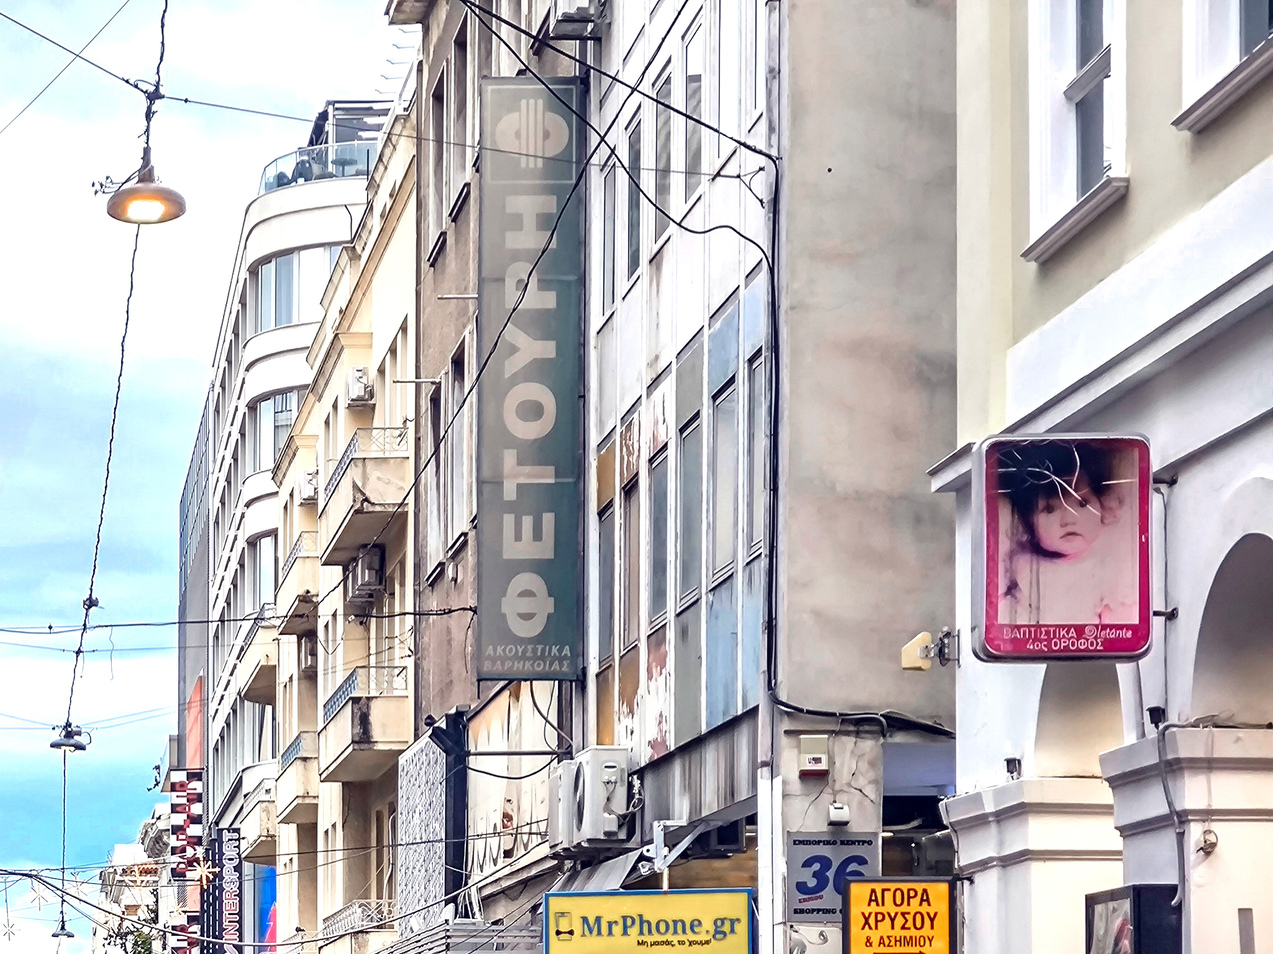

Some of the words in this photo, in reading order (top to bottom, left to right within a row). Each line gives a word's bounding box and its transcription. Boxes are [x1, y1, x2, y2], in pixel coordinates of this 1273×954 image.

[501, 193, 557, 639] ΦΕΤΟΥΡΗ
[1003, 627, 1076, 639] ΒΑΠΤΙΣΤΙΚΑ
[485, 644, 571, 657] ΑΚΟΥΣΤΙΚΑ
[1027, 639, 1048, 651] 4ος
[1052, 639, 1103, 650] ΟΡΟΦΟΣ
[795, 854, 869, 896] 36
[223, 830, 240, 942] INTERSPORT
[867, 888, 932, 907] ΑΓΟΡΑ
[580, 914, 742, 942] MrPhone.gr
[861, 911, 939, 931] ΧΡΥΣΟΥ
[637, 939, 649, 947] Μη
[865, 936, 874, 948] &
[877, 935, 935, 948] ΑΣΗΜΙΟΥ
